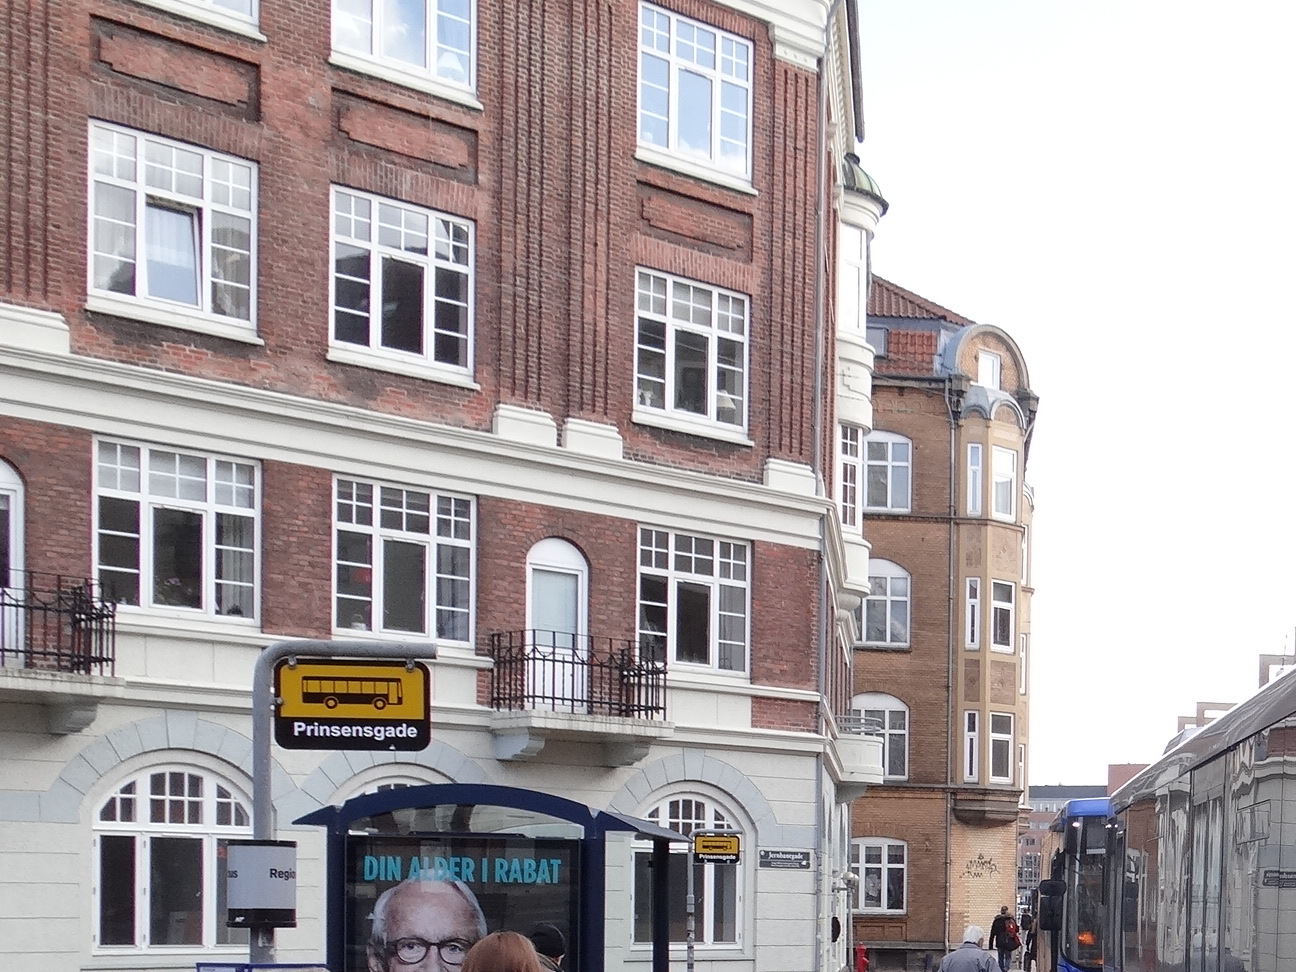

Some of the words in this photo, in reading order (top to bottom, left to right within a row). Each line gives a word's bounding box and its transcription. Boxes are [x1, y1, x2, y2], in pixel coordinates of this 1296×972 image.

[293, 721, 418, 740] Prinsensgade
[698, 853, 736, 861] Prinsensgade
[363, 855, 403, 881] DIN
[407, 856, 476, 883] ALDER
[481, 857, 488, 883] I
[494, 858, 562, 884] RABAT
